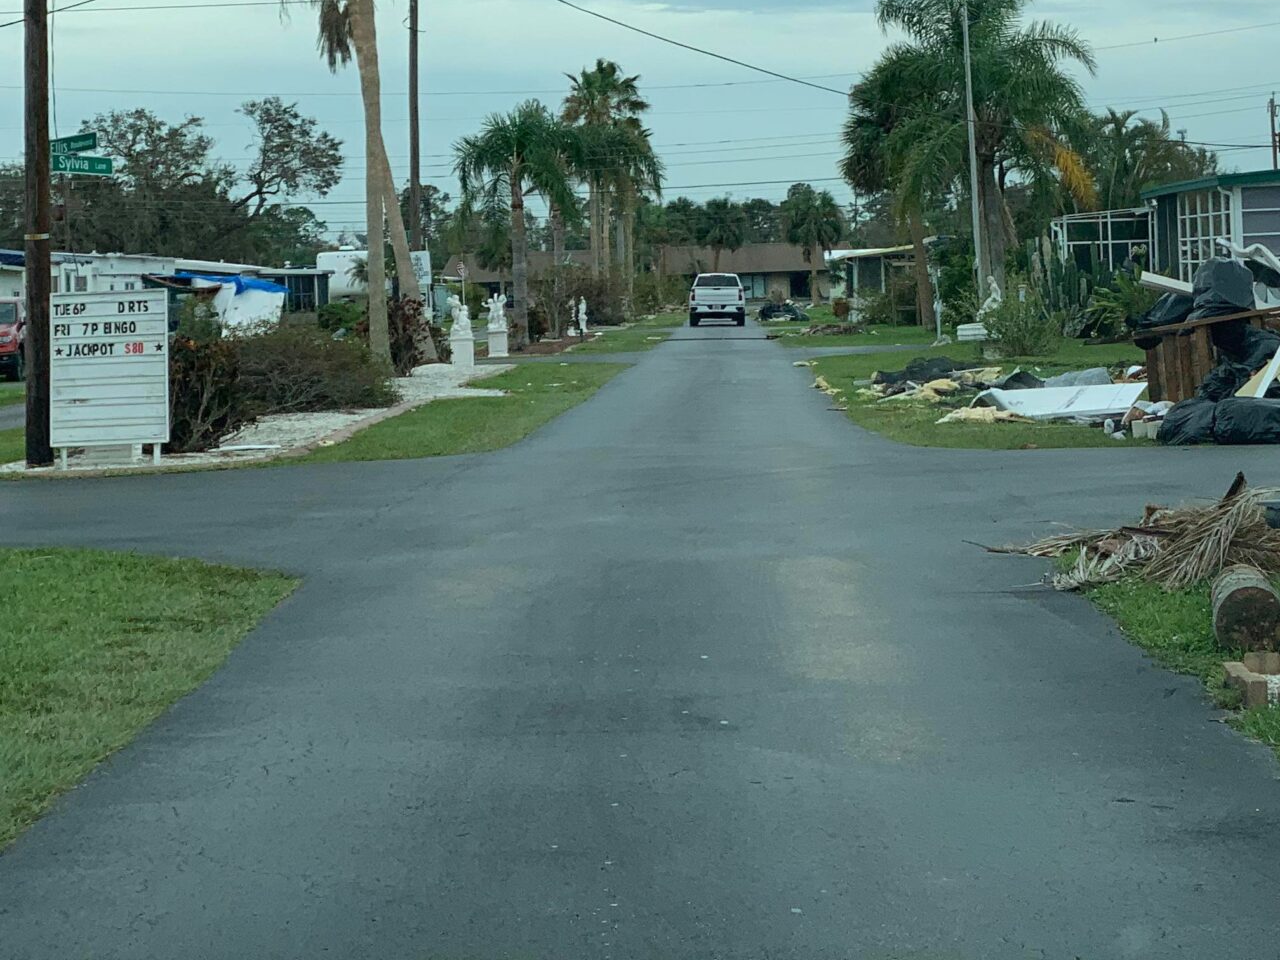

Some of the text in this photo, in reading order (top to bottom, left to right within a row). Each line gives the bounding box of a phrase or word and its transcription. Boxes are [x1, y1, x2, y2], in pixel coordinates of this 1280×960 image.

[58, 156, 89, 172] Sylvia
[53, 304, 70, 316] TUE
[54, 324, 71, 337] FRI
[66, 343, 115, 357] JACKPOT
